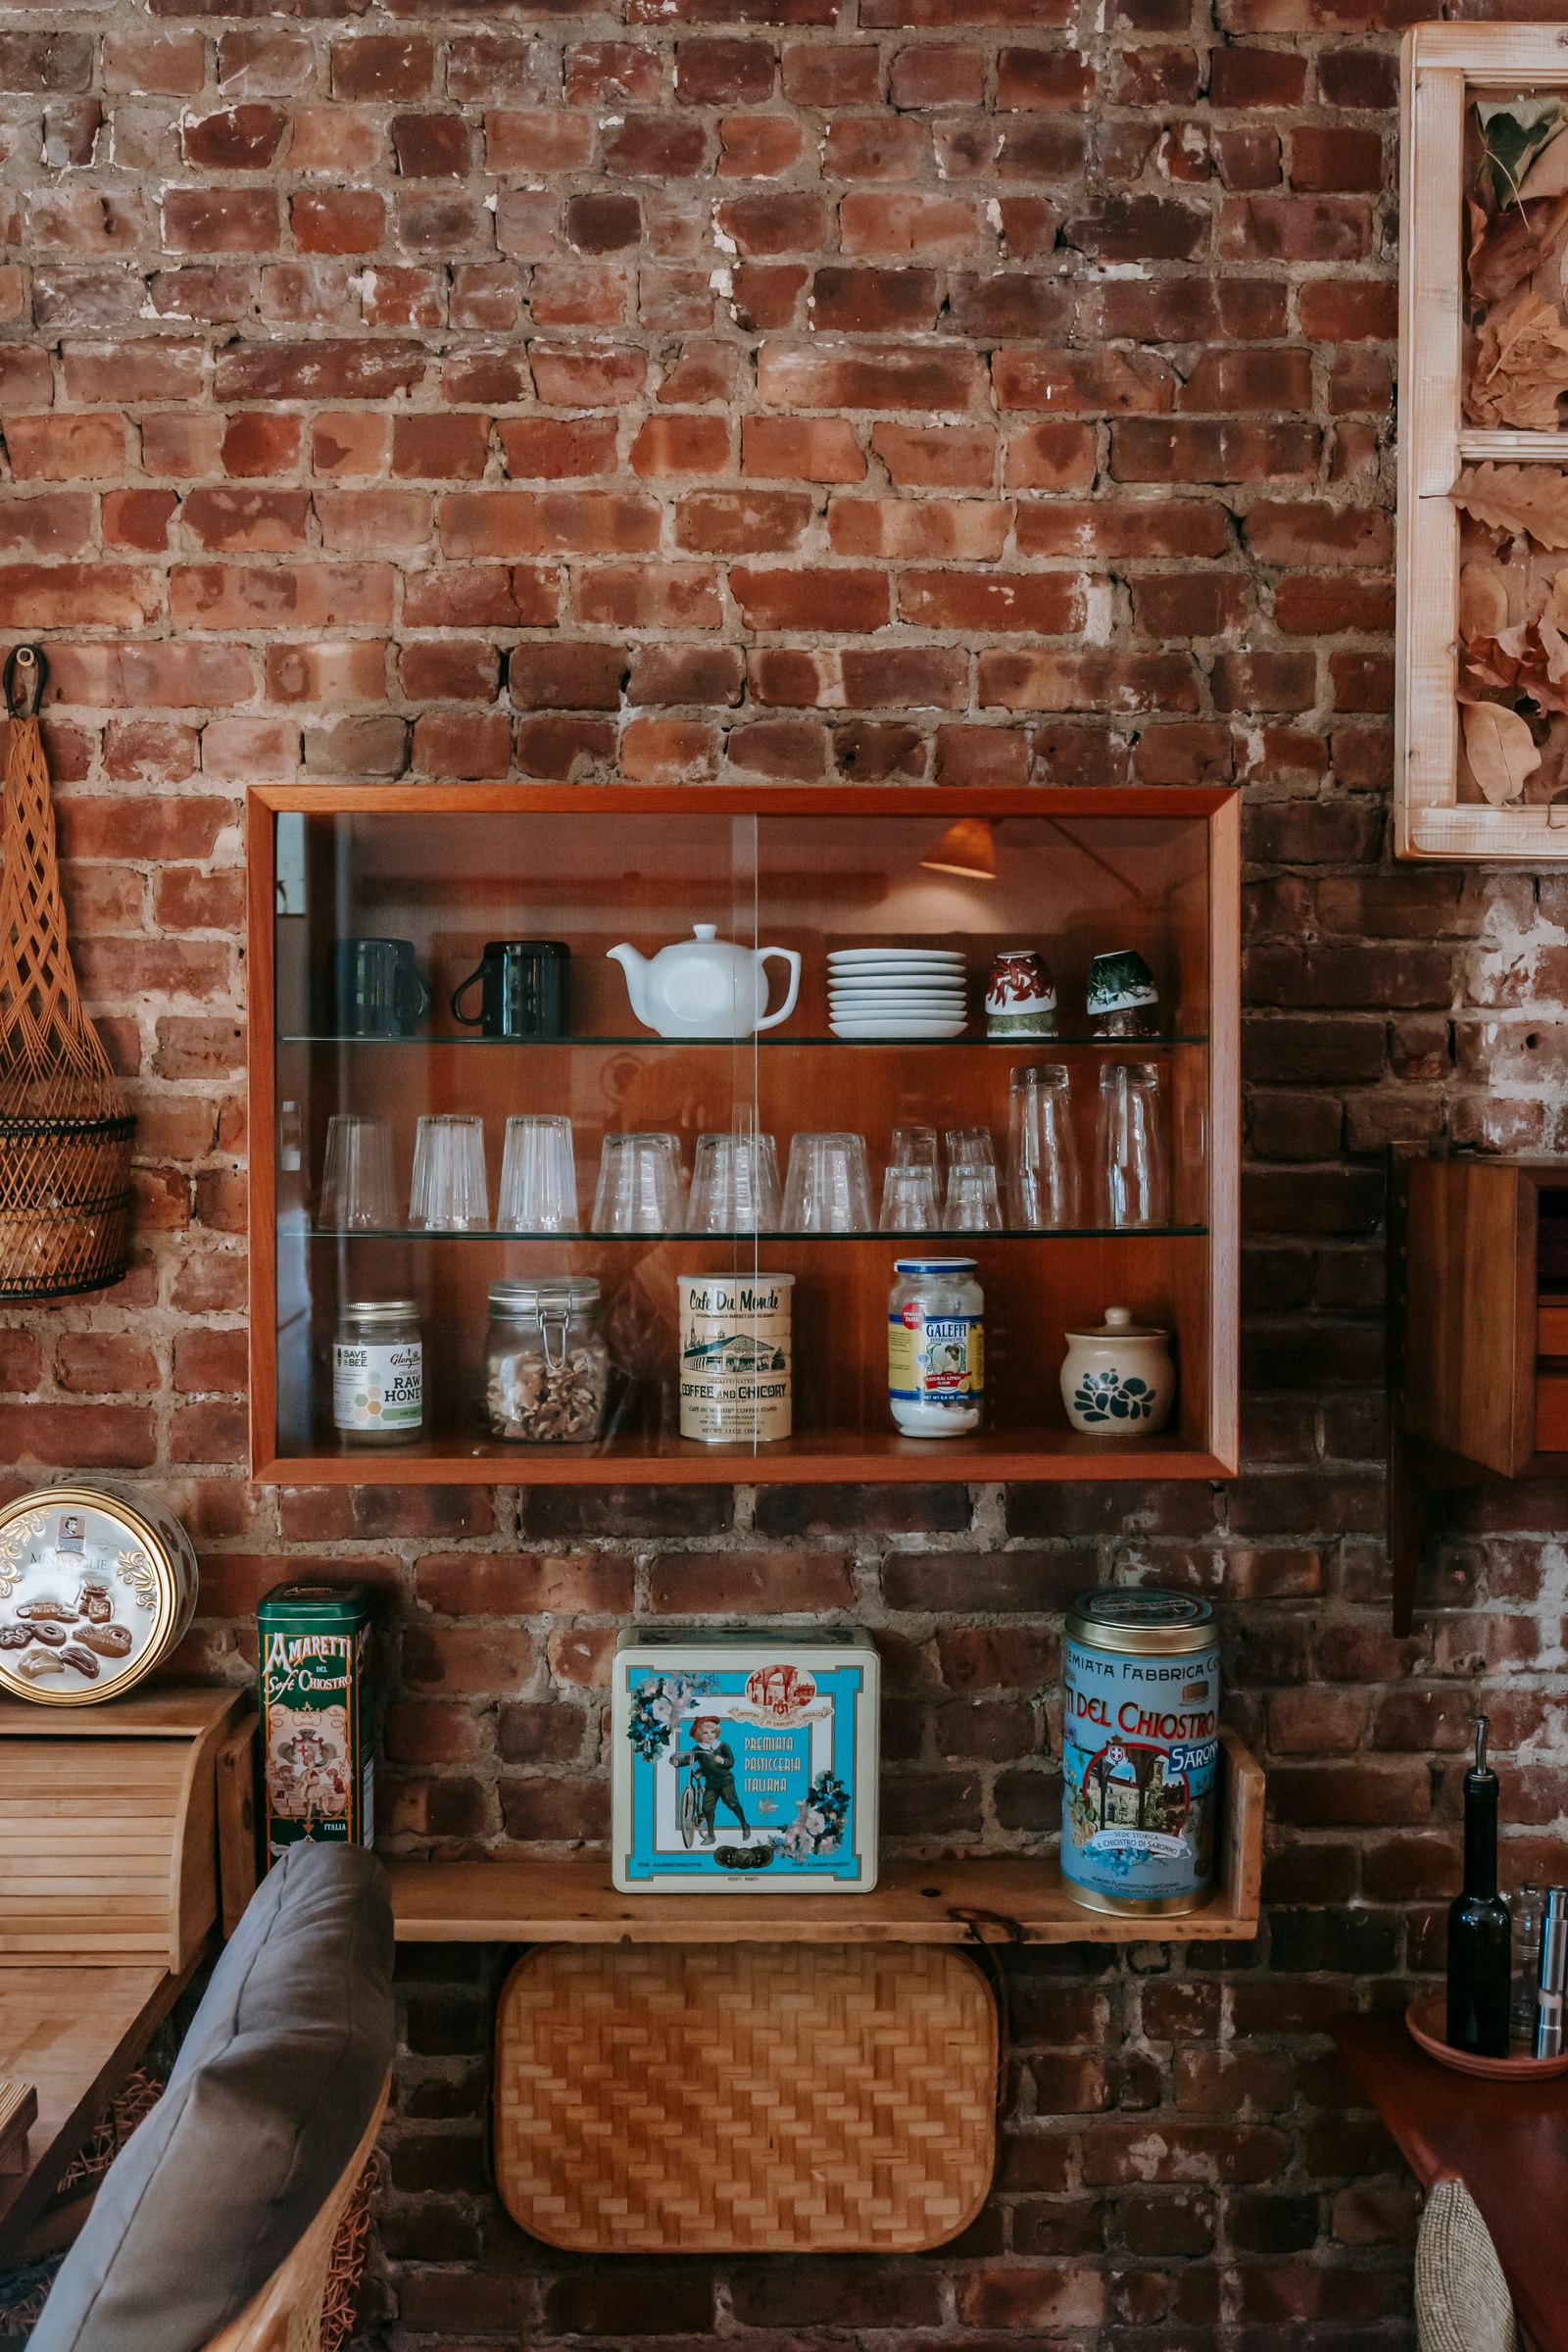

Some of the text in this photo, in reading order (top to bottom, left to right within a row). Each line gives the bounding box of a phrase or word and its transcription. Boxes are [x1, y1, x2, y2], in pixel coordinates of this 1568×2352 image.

[689, 1289, 779, 1311] Cafe Du Monde
[926, 1324, 967, 1338] GALEFFI
[343, 1349, 368, 1358] SAVE
[348, 1358, 368, 1367] BEE
[394, 1375, 420, 1390] RAW
[682, 1384, 787, 1399] COFFEE AND CHICORY
[262, 1632, 353, 1677] AMARETTI
[1067, 1650, 1115, 1678] EMIATA
[1122, 1663, 1204, 1682] FABBRICA
[264, 1669, 353, 1705] Soft CHIOSTRO
[1076, 1691, 1112, 1728] DEL
[1117, 1700, 1216, 1740] CHIOSTRO
[744, 1737, 794, 1751] PREMIATA
[744, 1757, 802, 1773] PASTICCERIA
[744, 1778, 788, 1792] ITALIANA
[1132, 1832, 1158, 1840] STORICA
[1102, 1838, 1137, 1847] CHIOSTRO
[1148, 1840, 1178, 1855] SARONNO
